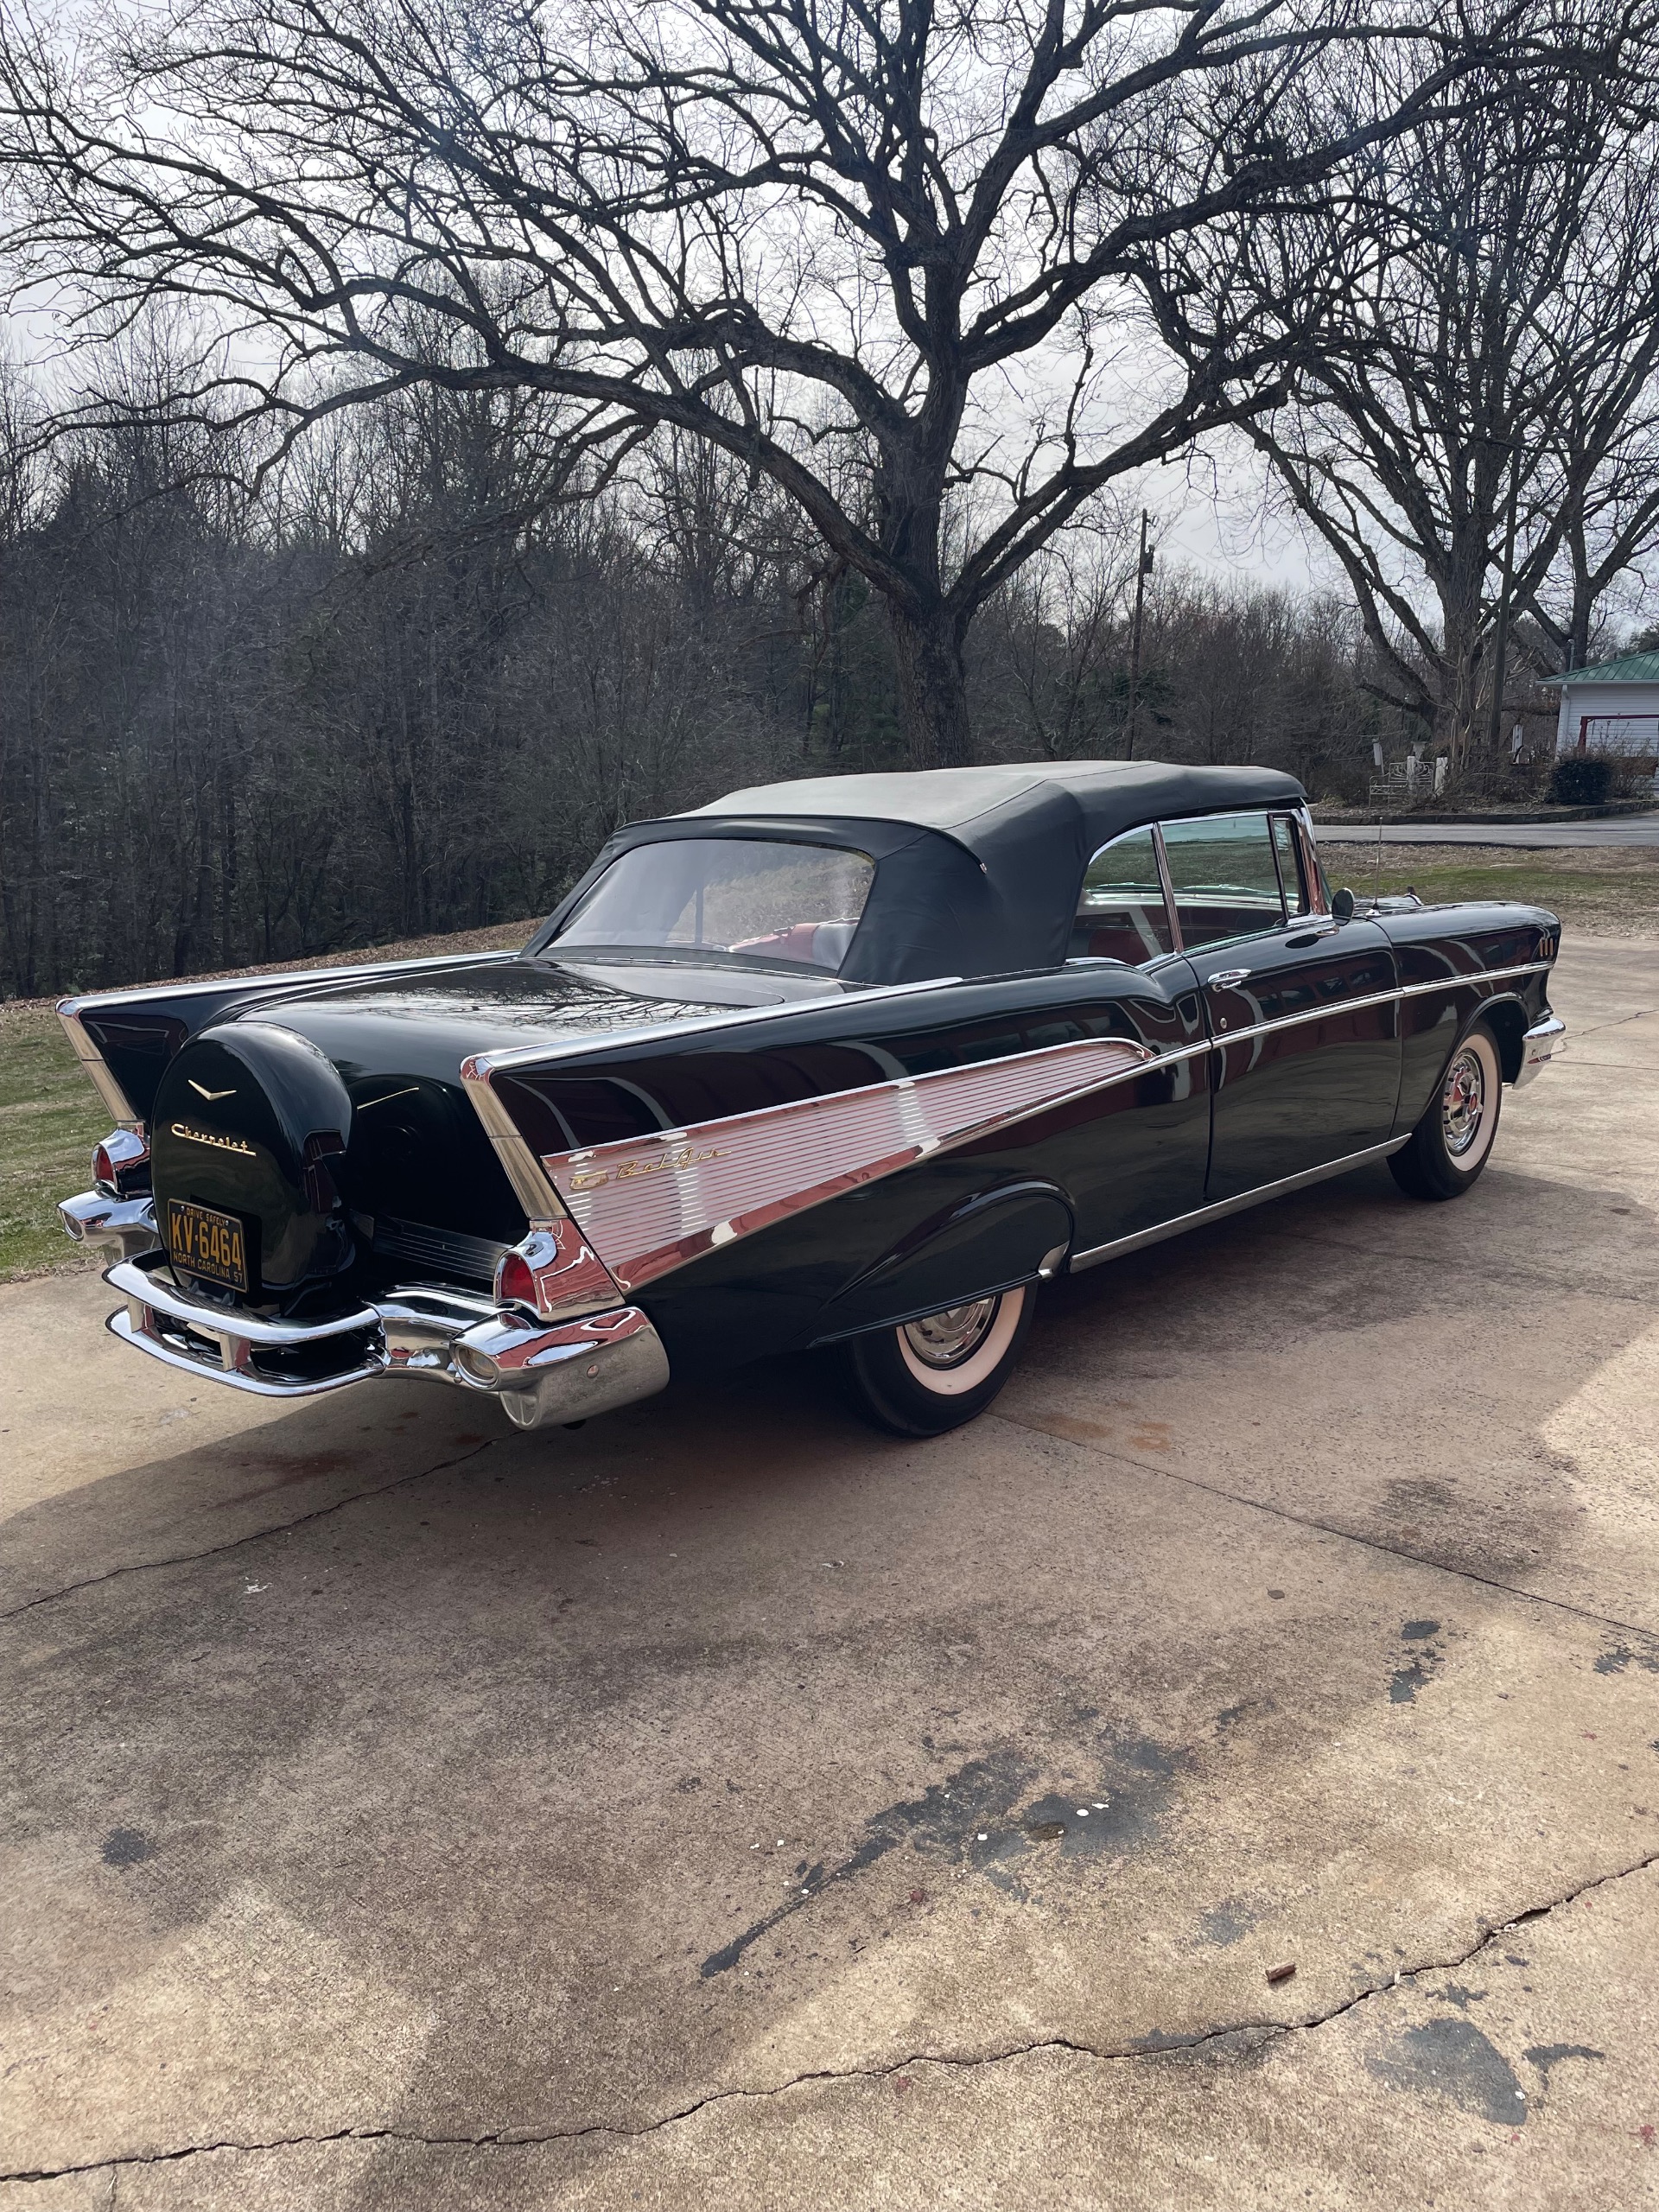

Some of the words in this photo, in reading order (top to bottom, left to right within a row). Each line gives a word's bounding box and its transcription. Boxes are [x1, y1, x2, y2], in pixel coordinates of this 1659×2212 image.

[171, 1123, 257, 1157] Chevrolet
[616, 1153, 668, 1179] Bel
[675, 1147, 732, 1170] Air
[186, 1207, 203, 1220] DRIVE
[206, 1213, 226, 1226] SAFELY
[174, 1251, 195, 1268] NORTH
[197, 1259, 231, 1280] CAROLINA
[233, 1271, 243, 1284] 57
